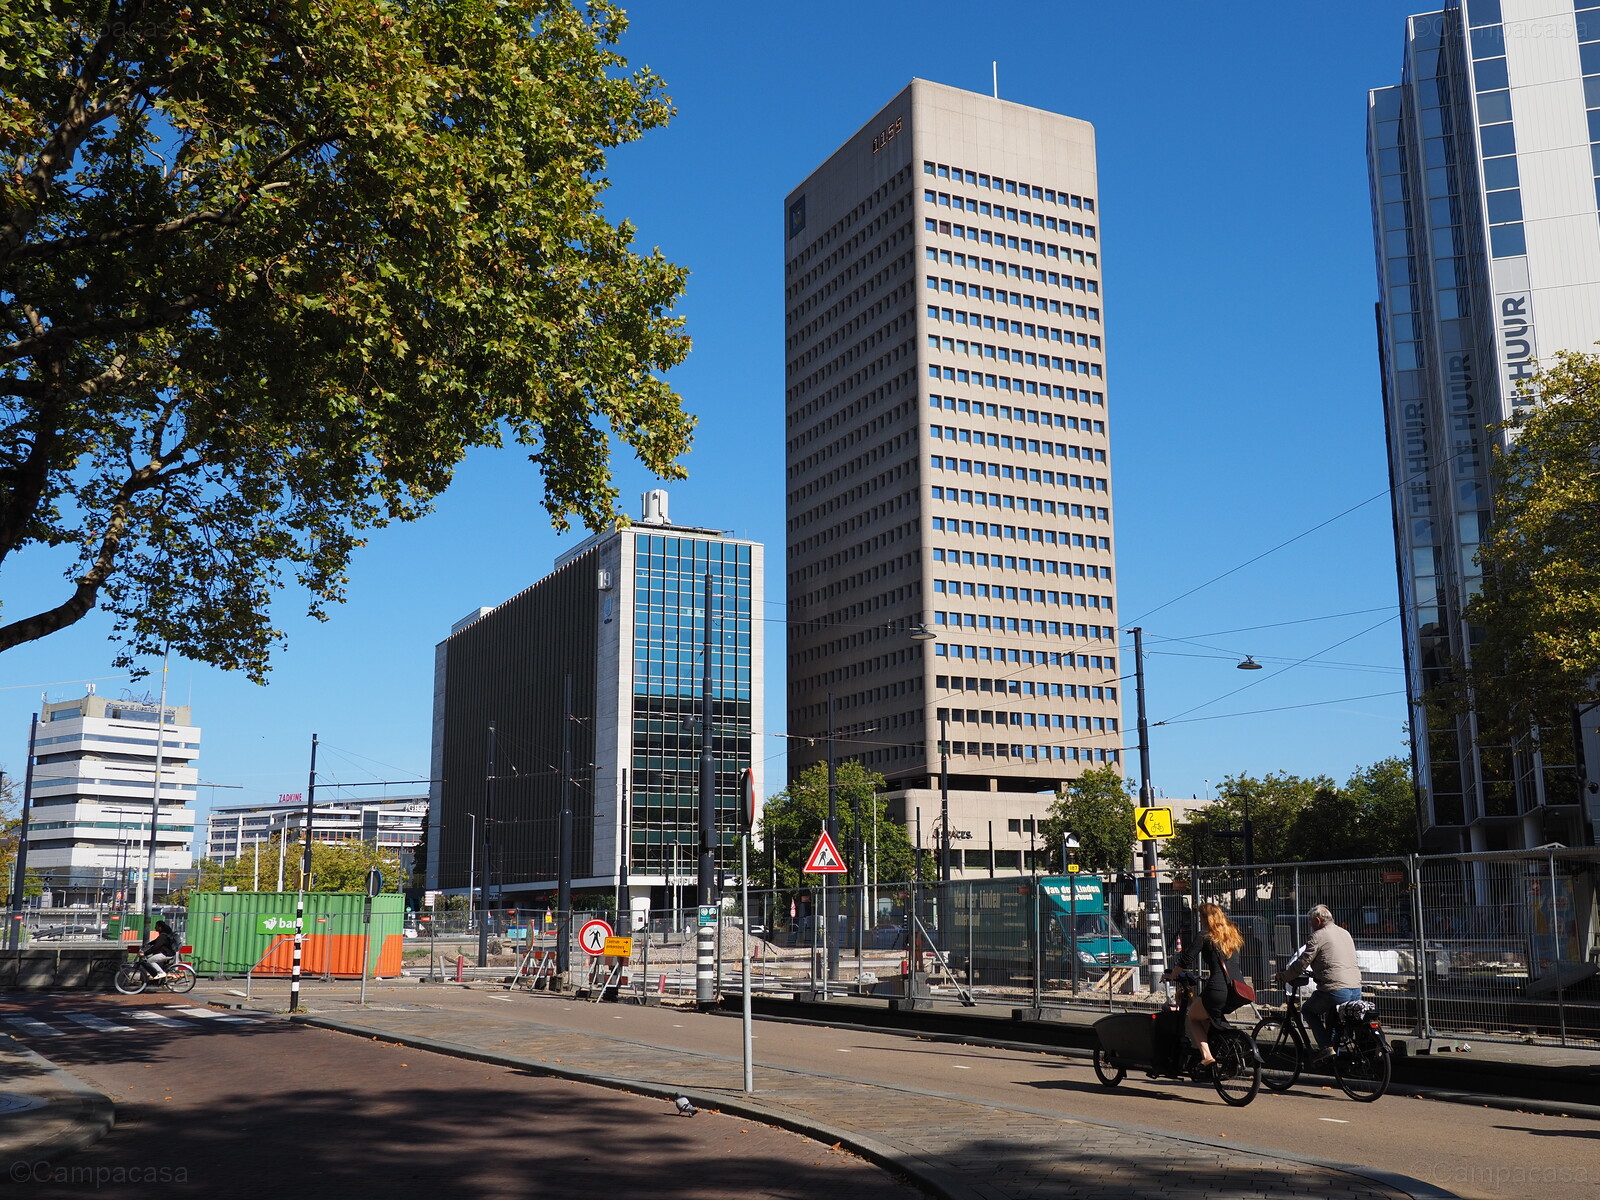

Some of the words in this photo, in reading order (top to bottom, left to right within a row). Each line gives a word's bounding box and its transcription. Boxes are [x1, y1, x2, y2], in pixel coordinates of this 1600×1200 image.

[1502, 296, 1533, 380] HUUR
[1449, 353, 1476, 431] HUUR
[1404, 402, 1430, 473] HUUR
[1458, 438, 1480, 474] TE
[1412, 481, 1433, 513] TE
[279, 793, 302, 803] ZADKINE
[1149, 812, 1154, 822] 2
[1044, 886, 1060, 895] Van
[1061, 885, 1074, 894] de
[1075, 884, 1101, 893] Linden
[1061, 893, 1094, 902] Ondrhoud
